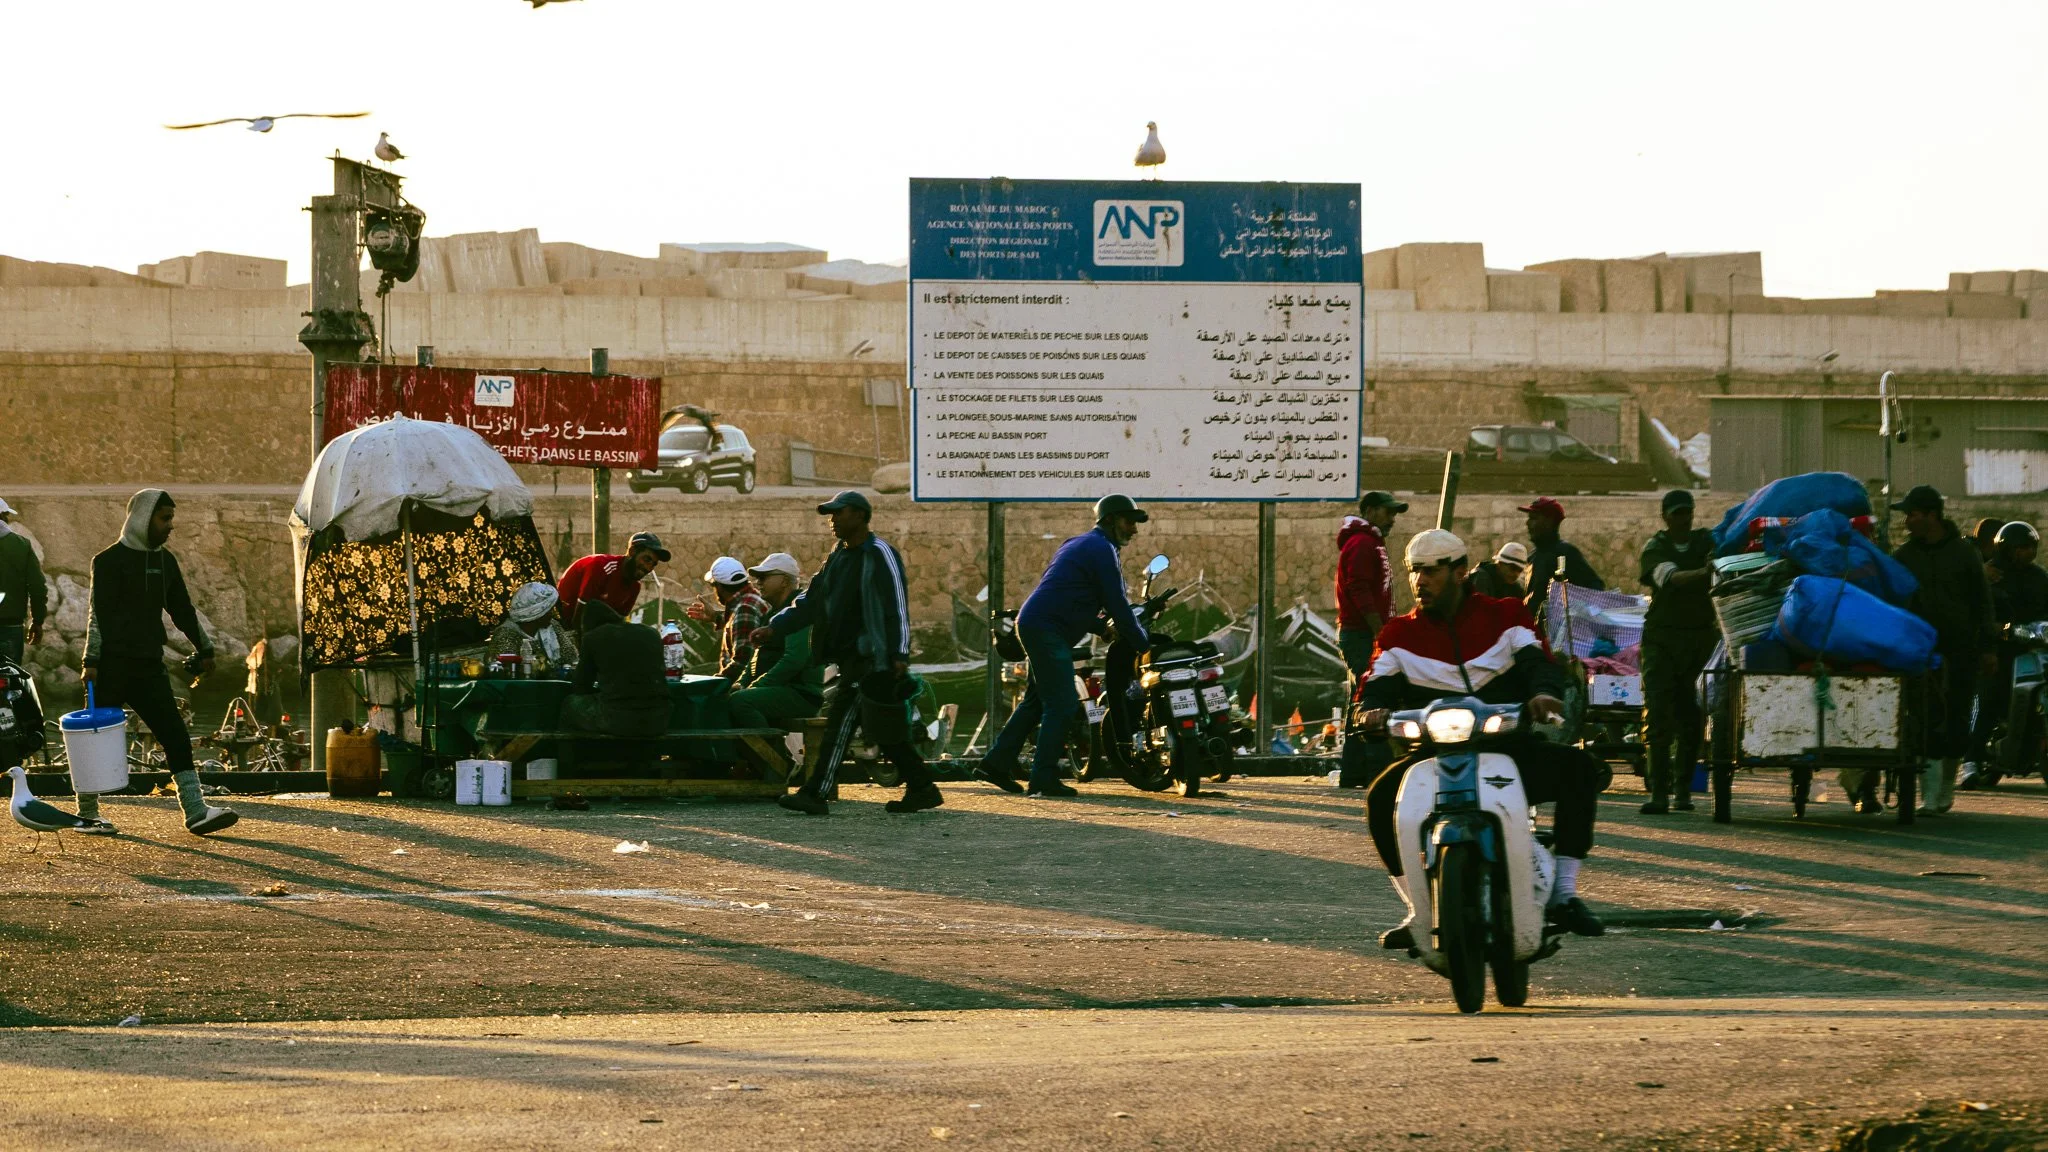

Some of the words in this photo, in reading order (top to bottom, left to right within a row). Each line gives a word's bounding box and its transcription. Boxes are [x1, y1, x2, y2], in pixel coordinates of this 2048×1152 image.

[949, 204, 997, 214] ROYAUME
[999, 205, 1012, 214] DU
[1014, 205, 1048, 214] MAROC
[1287, 210, 1319, 222] المملكة
[1097, 205, 1180, 239] ANP
[1250, 209, 1286, 224] المغربية
[927, 221, 965, 229] AGENCE
[967, 221, 1021, 230] NATIONALE
[1023, 222, 1042, 230] DES
[1043, 222, 1073, 230] PORTS
[1270, 226, 1302, 241] الوطنية
[1304, 226, 1333, 241] الوكالة
[950, 237, 998, 245] DIRECTION
[999, 237, 1049, 246] REGIONALE
[960, 250, 976, 259] DES
[978, 250, 1005, 259] PORTS
[1007, 250, 1019, 259] DE
[1019, 250, 1040, 259] SAFI
[1277, 243, 1311, 258] الجهوية
[1313, 244, 1348, 258] المديرية
[924, 294, 931, 302] Il
[934, 294, 952, 303] est
[954, 294, 1019, 304] strictement
[1022, 295, 1062, 304] interdit
[1296, 295, 1322, 307] منعا
[1324, 295, 1351, 313] يمنع
[1239, 331, 1257, 346] على
[1260, 332, 1289, 345] الصيد
[1291, 332, 1320, 342] معدات
[1323, 331, 1342, 345] ترك
[1255, 351, 1274, 366] على
[1278, 351, 1320, 365] الصناديق
[1323, 351, 1342, 365] ترك
[1271, 370, 1290, 385] على
[1294, 371, 1323, 381] السمك
[1326, 371, 1342, 385] بيع
[477, 379, 512, 393] ANP
[1255, 392, 1274, 407] على
[1278, 392, 1308, 403] الشباك
[1311, 392, 1340, 406] تخزين
[1204, 411, 1242, 425] ترخيص
[1243, 412, 1269, 425] بدون
[1271, 411, 1306, 425] بالميناء
[520, 421, 559, 440] رمي
[1244, 431, 1274, 444] الميناء
[1278, 431, 1311, 444] بحوض
[1313, 431, 1340, 444] الصيد
[541, 447, 576, 460] DANS
[578, 449, 591, 461] LE
[594, 449, 639, 463] BASSIN
[1211, 449, 1244, 463] الميناء
[1247, 450, 1277, 463] حوض
[1303, 448, 1340, 463] السباحة
[1252, 468, 1271, 483] على
[1275, 469, 1315, 482] السيارات
[1318, 470, 1339, 482] رص
